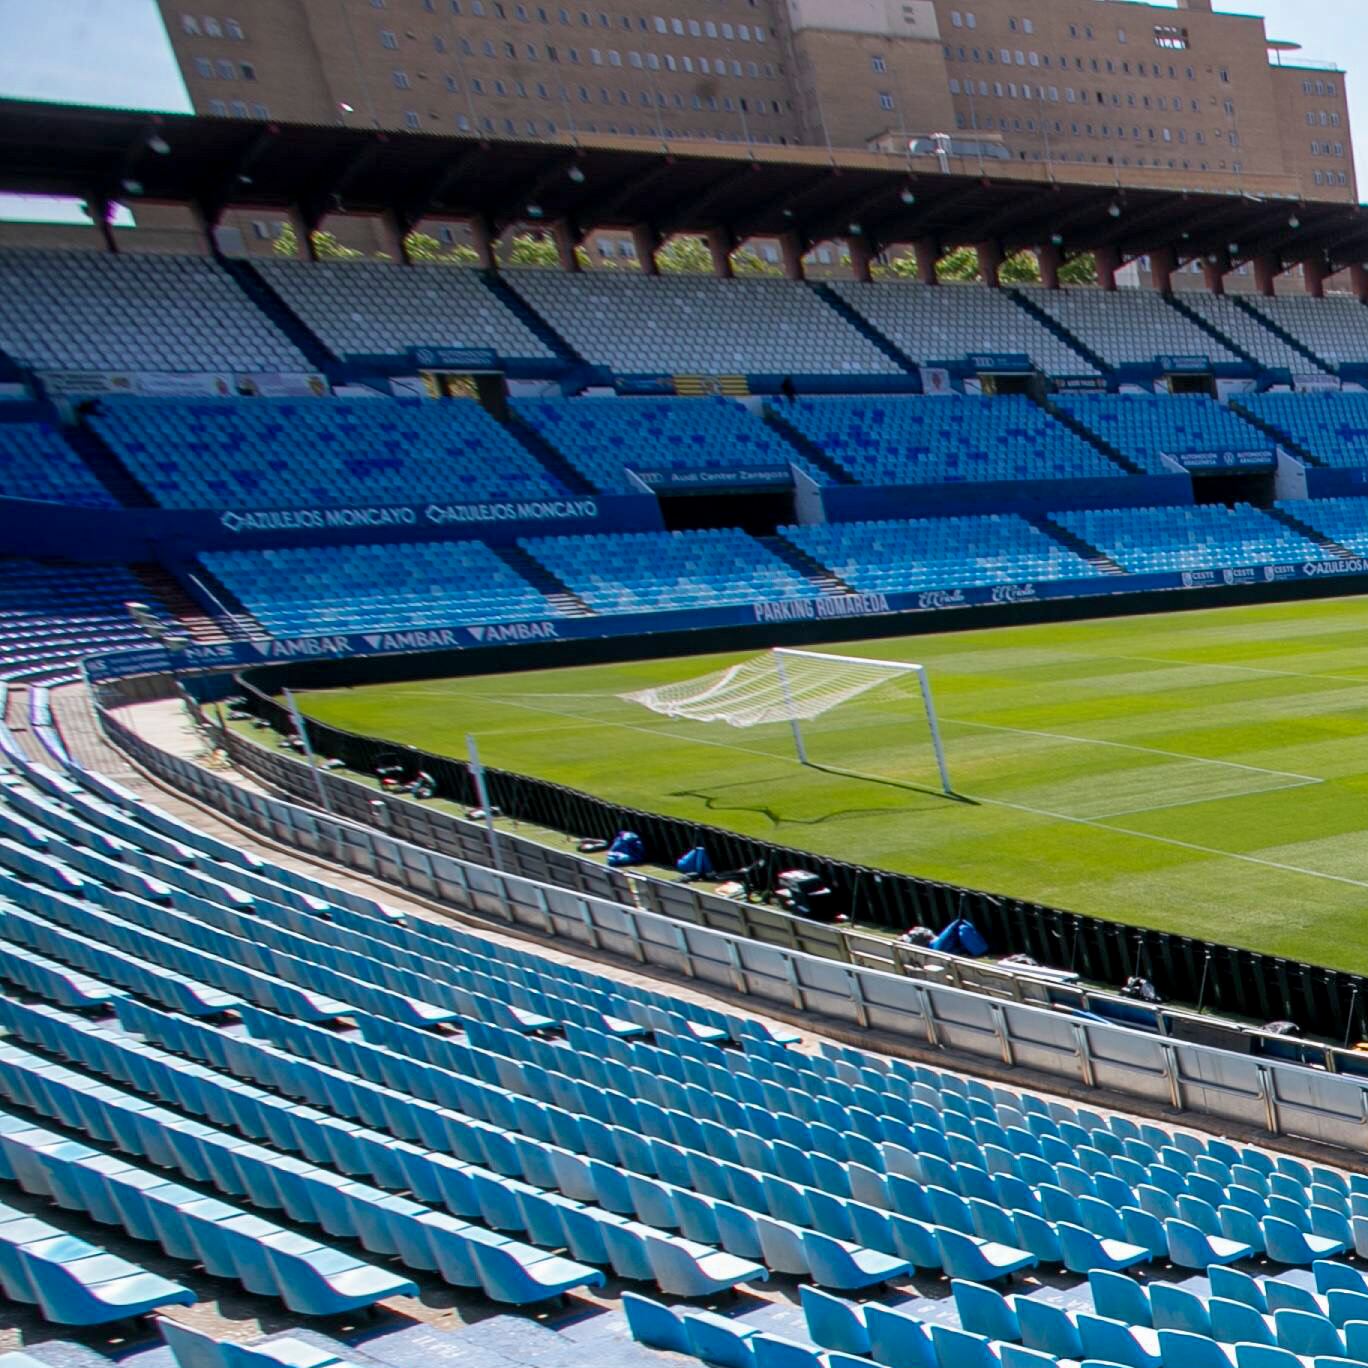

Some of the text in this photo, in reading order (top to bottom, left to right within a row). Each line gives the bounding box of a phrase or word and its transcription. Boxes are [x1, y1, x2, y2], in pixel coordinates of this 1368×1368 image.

[672, 470, 790, 482] Audi Center Zaragoza
[245, 507, 416, 529] AZULEJOS MONCAYO
[447, 500, 597, 521] AZULEJOS MONCAYO
[1232, 569, 1254, 578] CESTE
[1273, 565, 1294, 574] CESTE
[1316, 557, 1362, 574] AZULEJOS
[1191, 572, 1214, 581] CESTE
[754, 594, 889, 622] PARKING ROMAREDA
[384, 629, 458, 650] AMBAR
[487, 621, 559, 642] AMBAR
[273, 636, 354, 657] AMBAR
